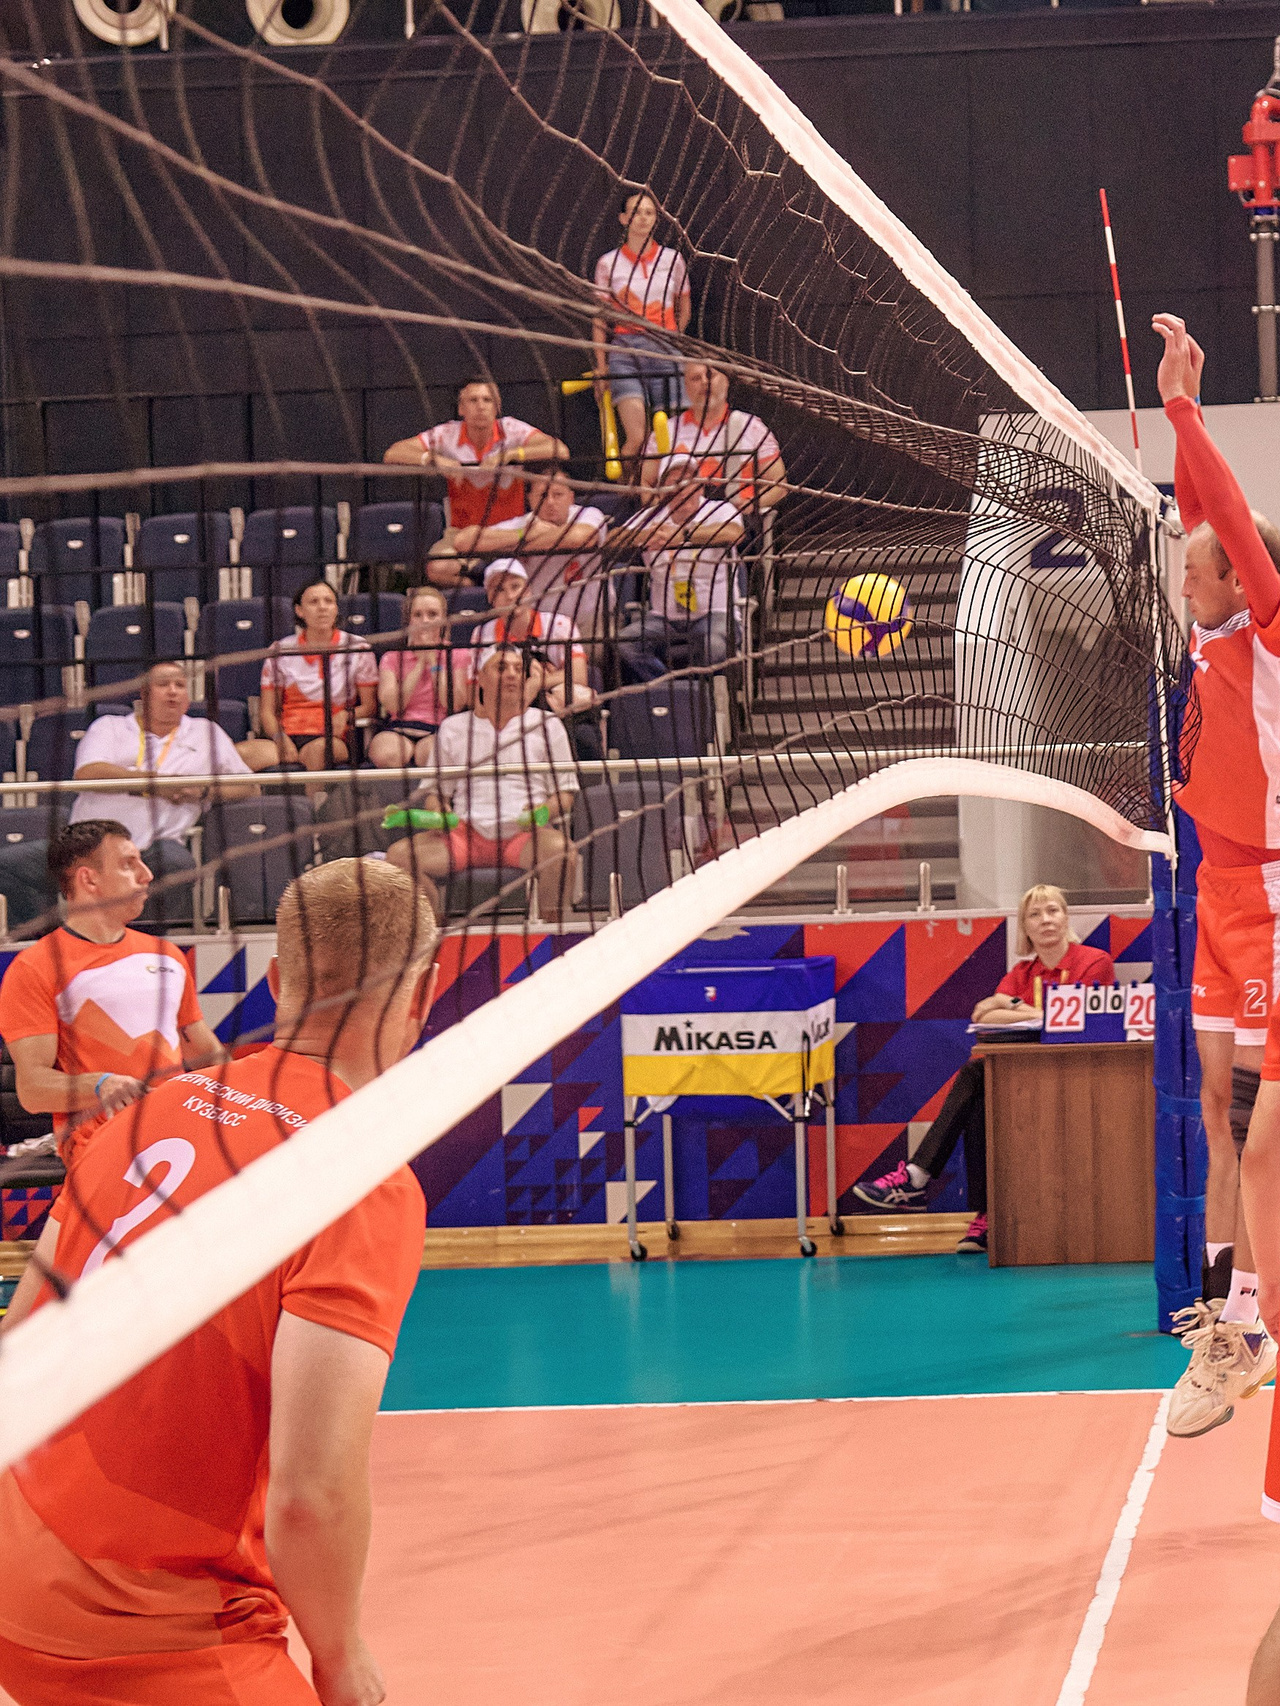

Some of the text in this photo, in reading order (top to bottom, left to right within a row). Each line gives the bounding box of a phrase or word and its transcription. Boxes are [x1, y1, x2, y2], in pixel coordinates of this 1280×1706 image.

[1050, 996, 1081, 1027] 22
[1128, 995, 1155, 1025] 20
[1243, 979, 1267, 1017] 2
[182, 1095, 248, 1127] КУЗБАСС
